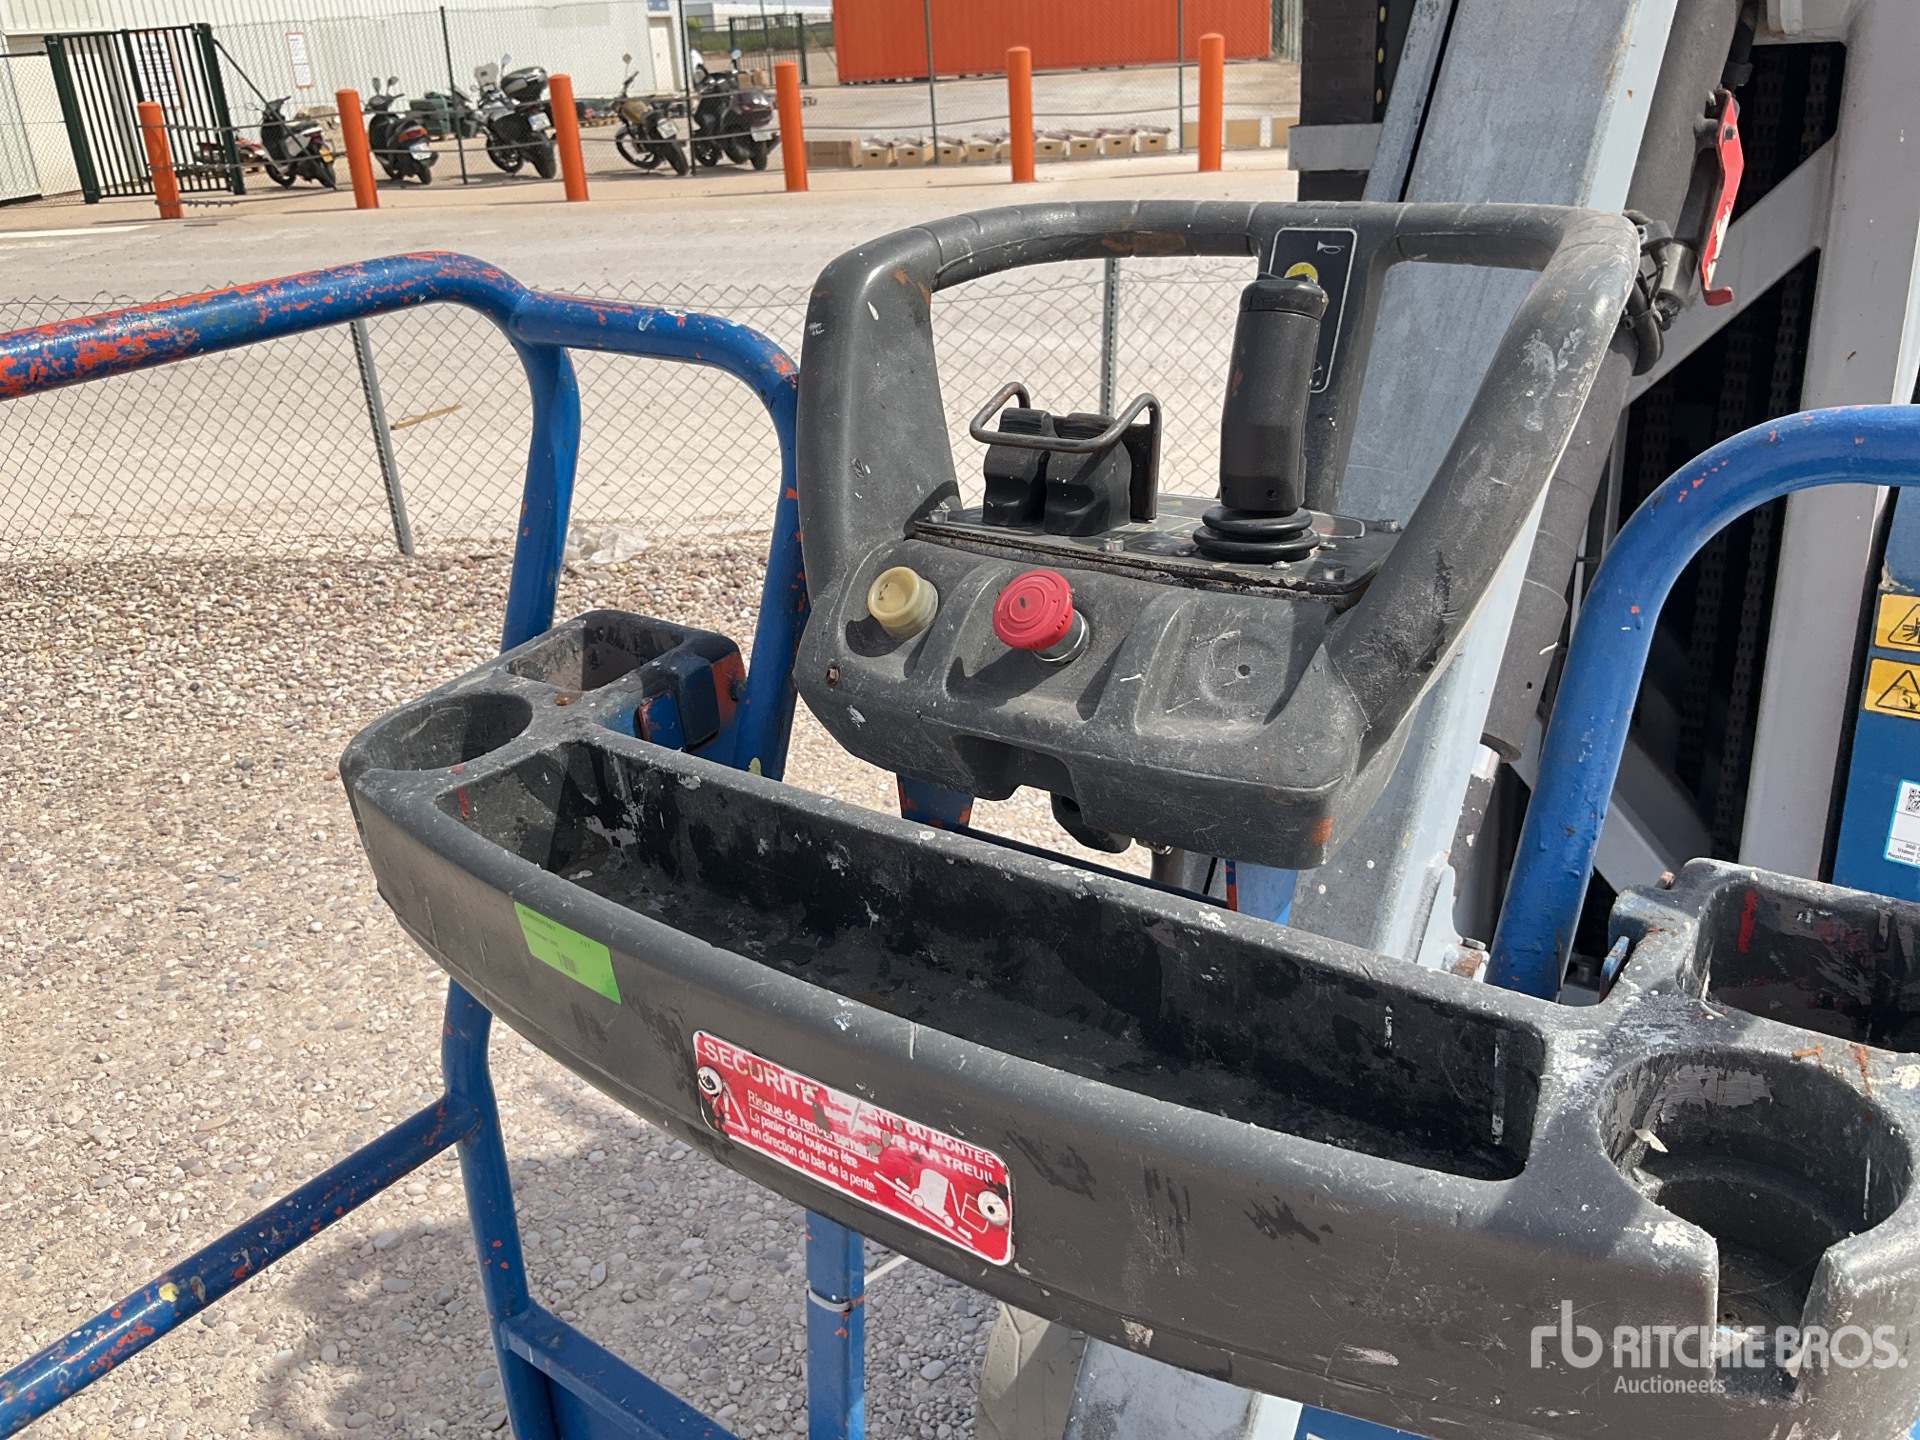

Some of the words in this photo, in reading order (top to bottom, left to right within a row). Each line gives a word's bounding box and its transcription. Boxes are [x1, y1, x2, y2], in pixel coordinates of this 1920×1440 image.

[747, 1089, 783, 1117] Risque
[784, 1109, 798, 1126] de
[749, 1107, 760, 1123] Le
[761, 1114, 786, 1134] panier
[787, 1124, 804, 1143] doit
[803, 1133, 839, 1161] toujours
[840, 1147, 858, 1169] être
[750, 1127, 762, 1141] en
[762, 1131, 797, 1158] direction
[798, 1147, 810, 1163] du
[810, 1154, 827, 1171] bas
[827, 1162, 839, 1177] de
[839, 1165, 849, 1182] la
[849, 1173, 878, 1194] pente.
[905, 1121, 927, 1142] OU
[930, 1131, 995, 1169] MONTEE
